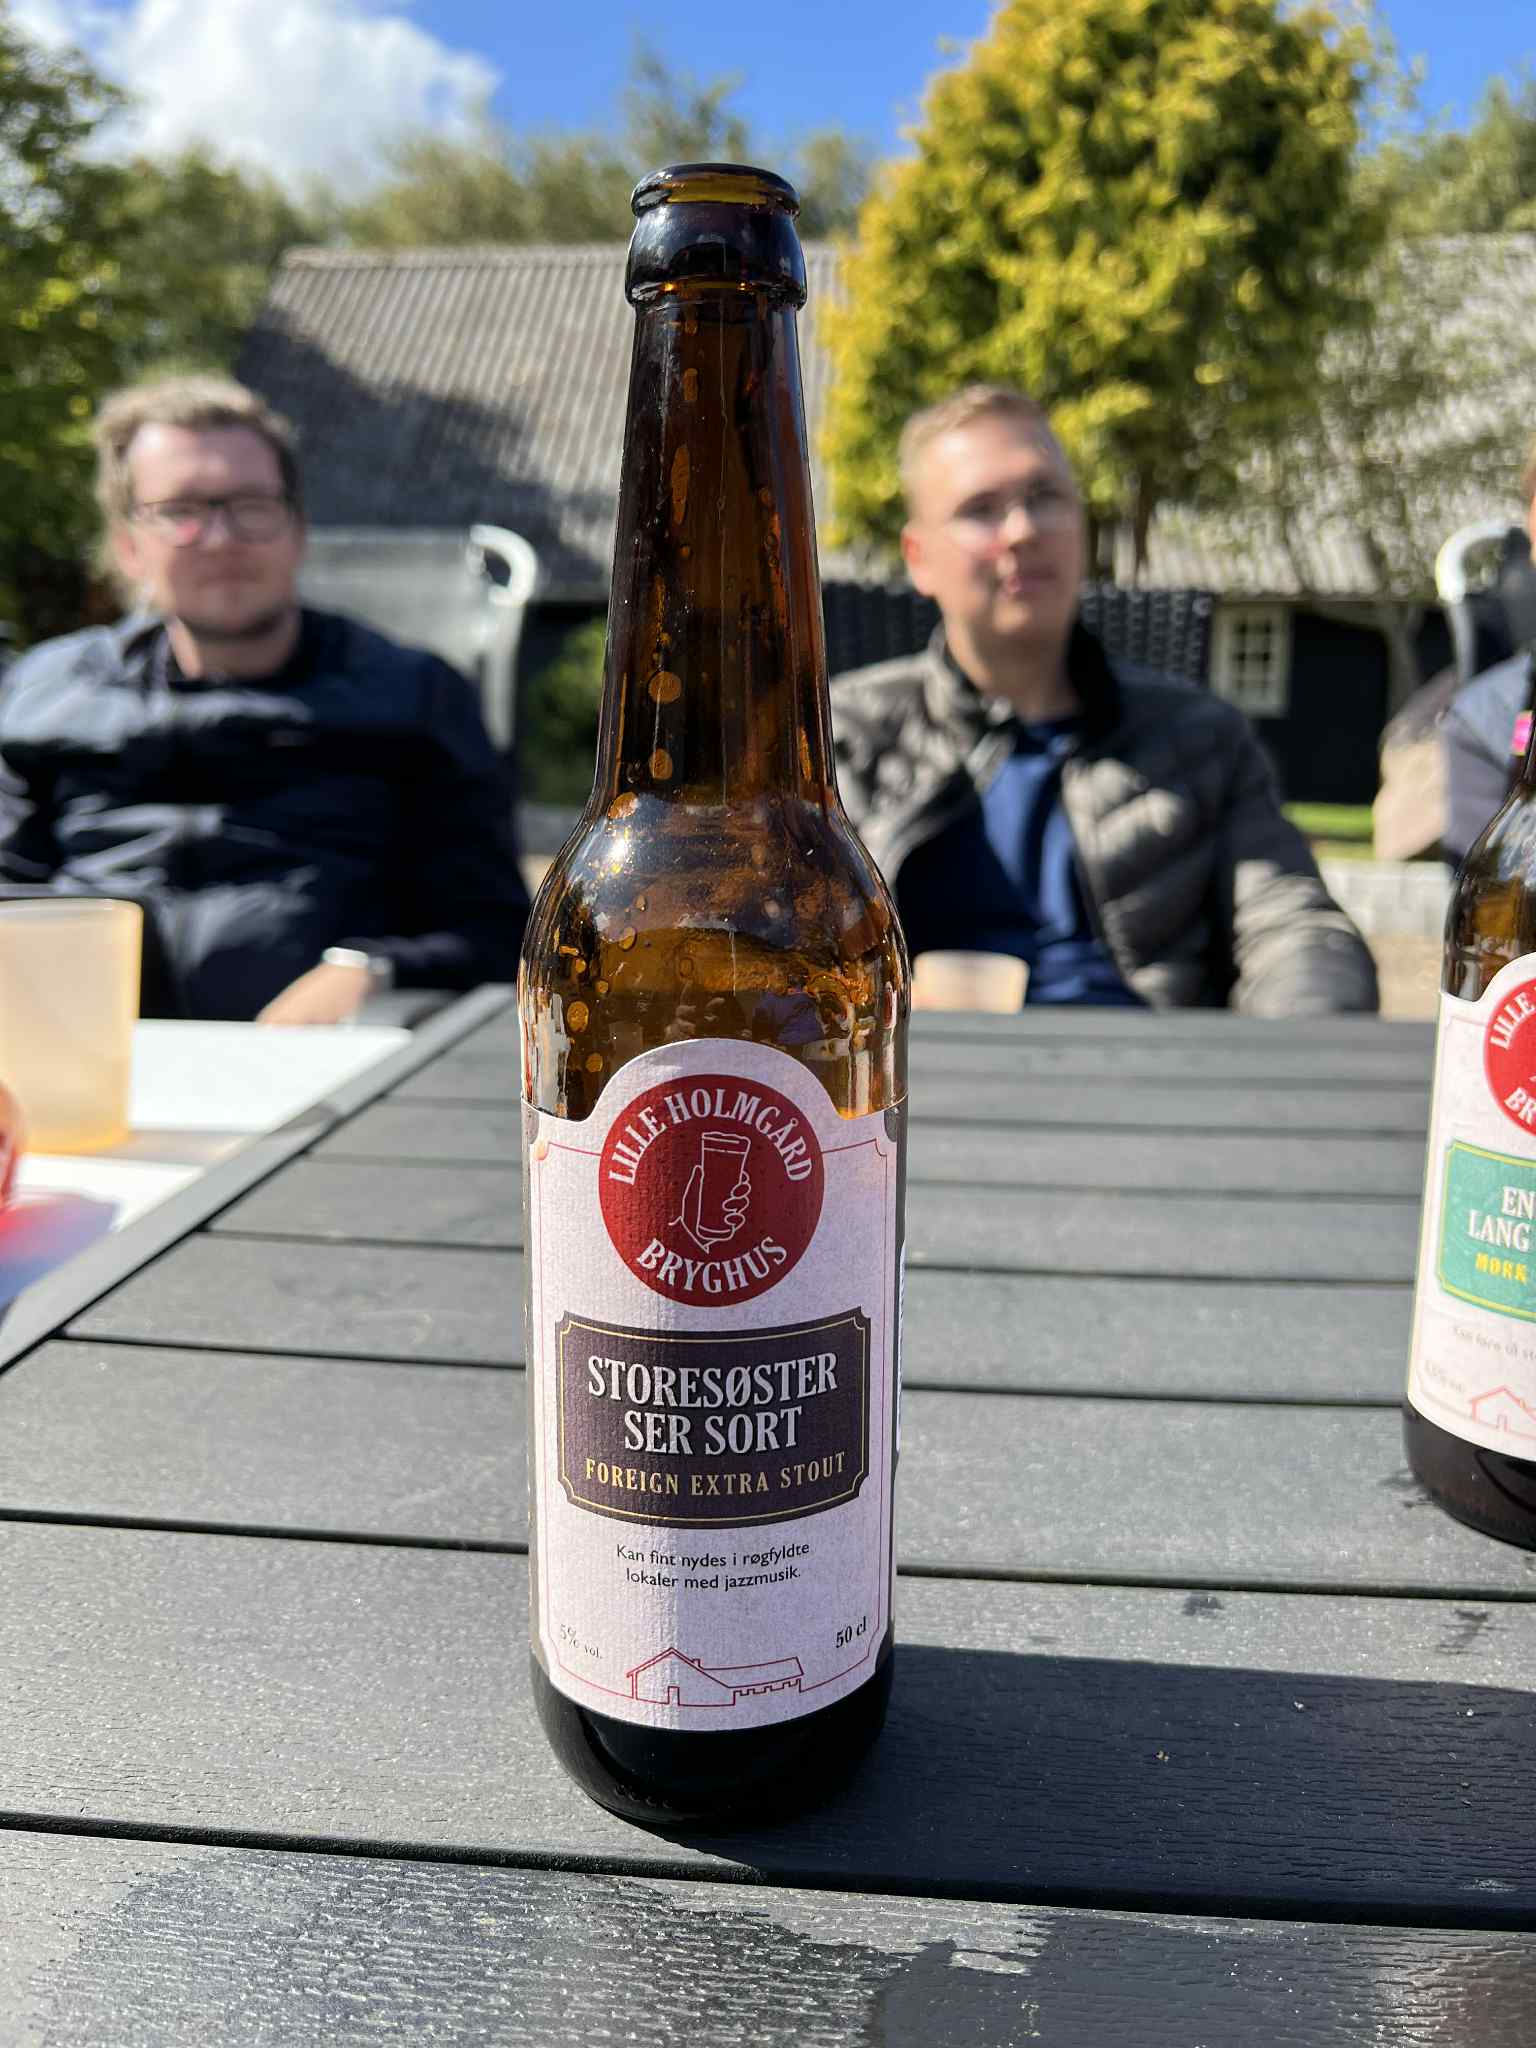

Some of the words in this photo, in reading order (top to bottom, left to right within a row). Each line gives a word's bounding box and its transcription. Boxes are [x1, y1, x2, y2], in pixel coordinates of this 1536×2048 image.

[1489, 992, 1536, 1050] LILLE
[608, 1106, 668, 1186] LILLE
[663, 1087, 813, 1182] HOLMGÅRD
[1467, 1208, 1531, 1252] LANG
[636, 1235, 789, 1294] BRYGHUS
[587, 1351, 838, 1409] STORESØSTER
[624, 1410, 693, 1455] SER
[705, 1406, 802, 1455] SORT
[585, 1457, 679, 1496] FOREIGN
[690, 1472, 770, 1496] EXTRA
[780, 1451, 846, 1489] STOUT
[616, 1544, 645, 1561] Kan
[650, 1550, 679, 1566] fint
[681, 1553, 727, 1571] nydes
[732, 1552, 737, 1567] i
[743, 1543, 810, 1567] røgfyldte
[626, 1567, 679, 1587] lokaler
[684, 1575, 719, 1589] med
[725, 1565, 801, 1591] jazzmusik.
[836, 1625, 853, 1649] 50
[856, 1615, 866, 1636] cl
